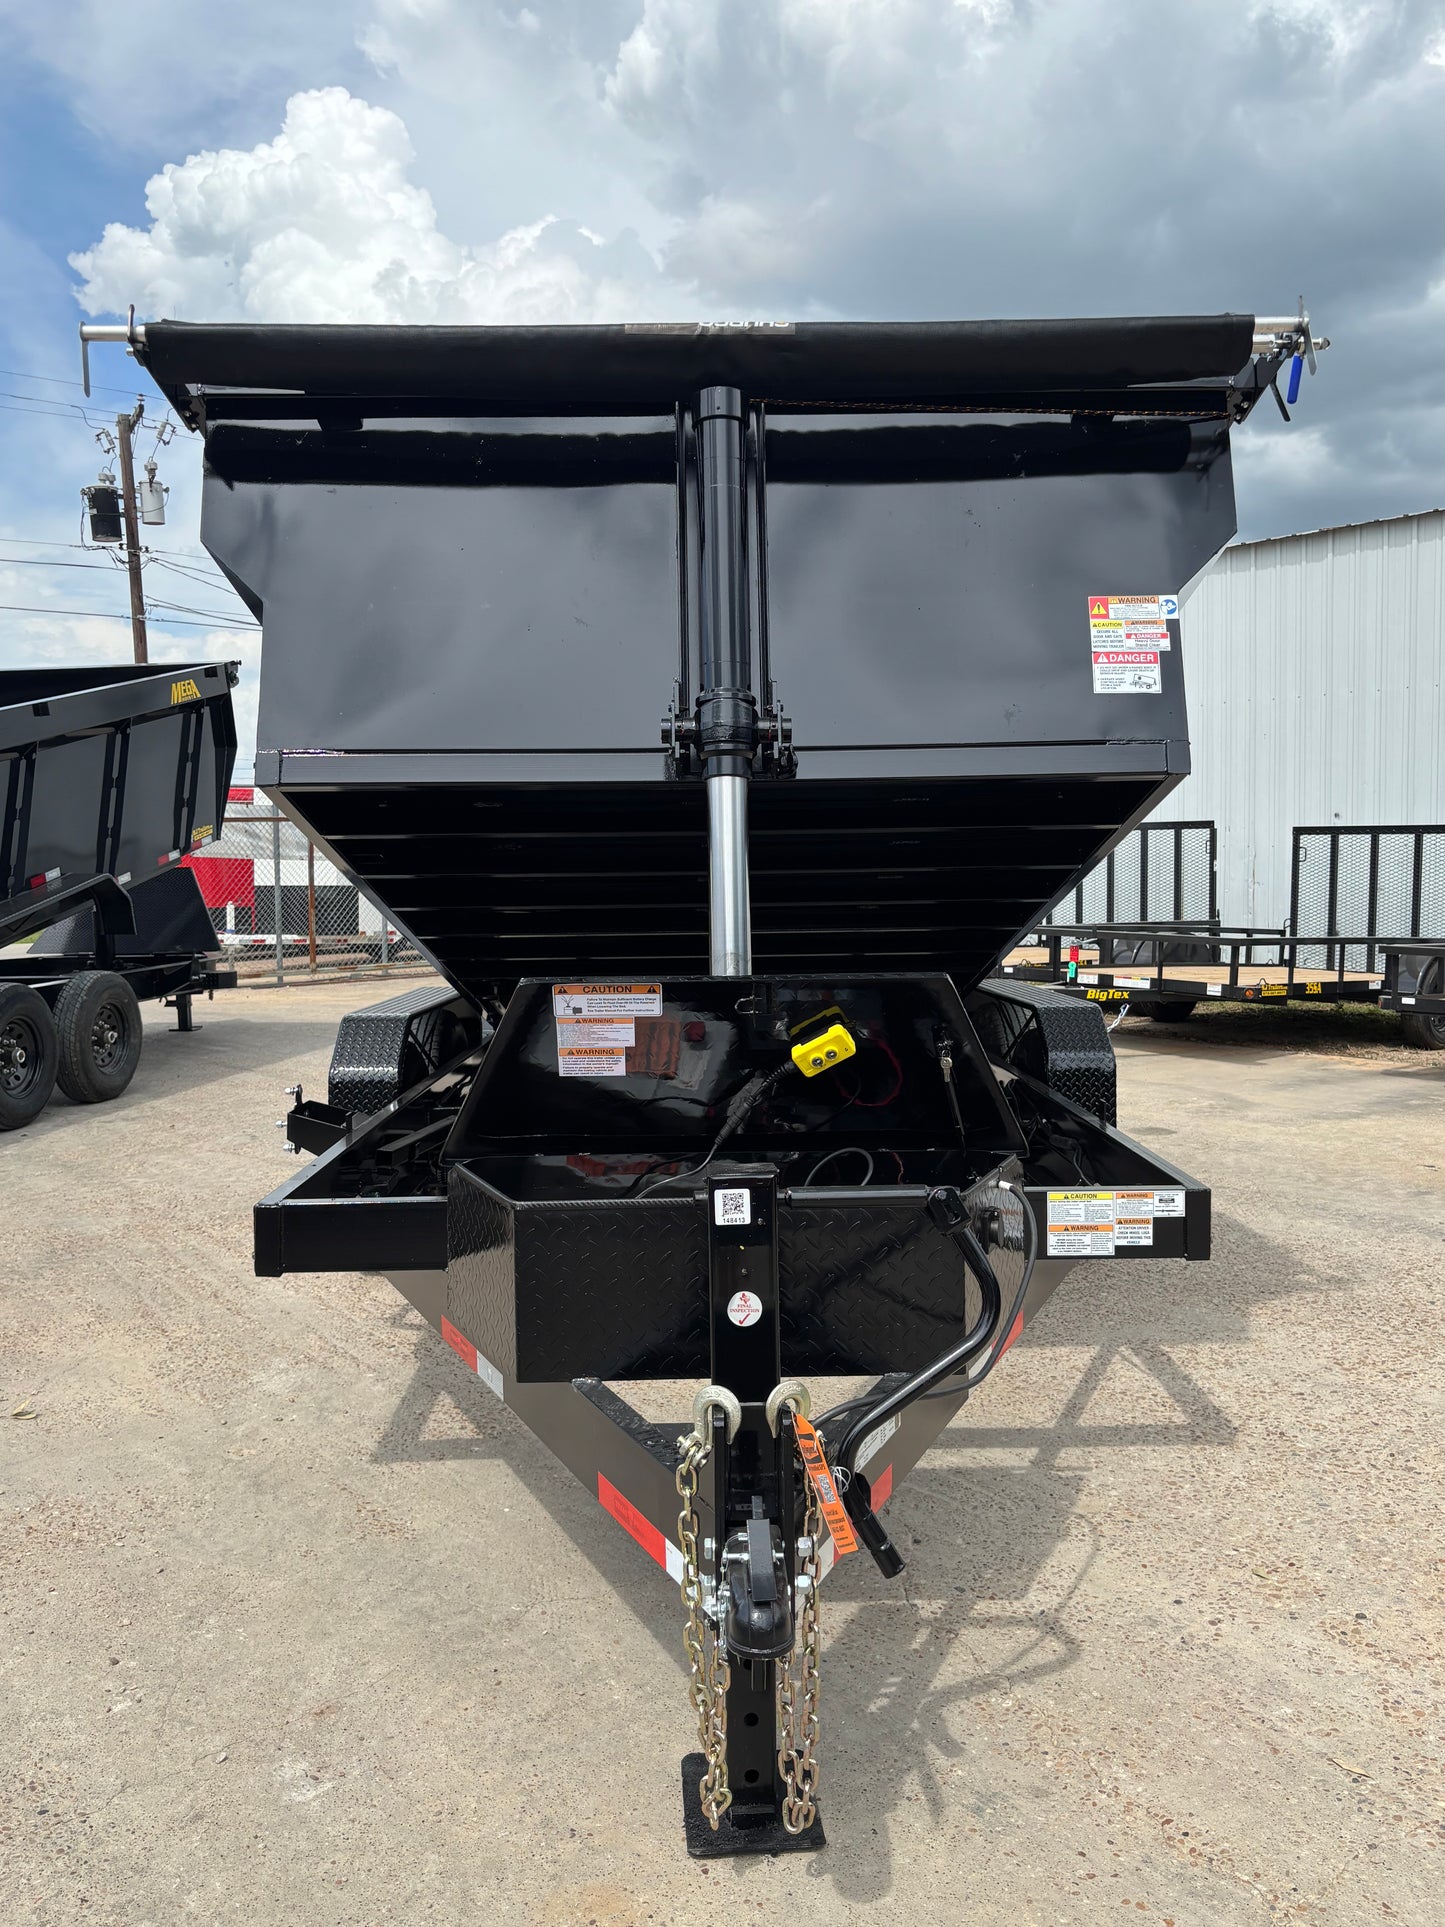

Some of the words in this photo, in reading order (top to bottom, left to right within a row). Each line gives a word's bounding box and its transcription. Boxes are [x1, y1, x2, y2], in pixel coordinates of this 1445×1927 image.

[1109, 654, 1154, 662] DANGER
[171, 679, 201, 704] MEGA
[582, 985, 632, 993] CAUTION
[1086, 989, 1130, 1001] BigTex
